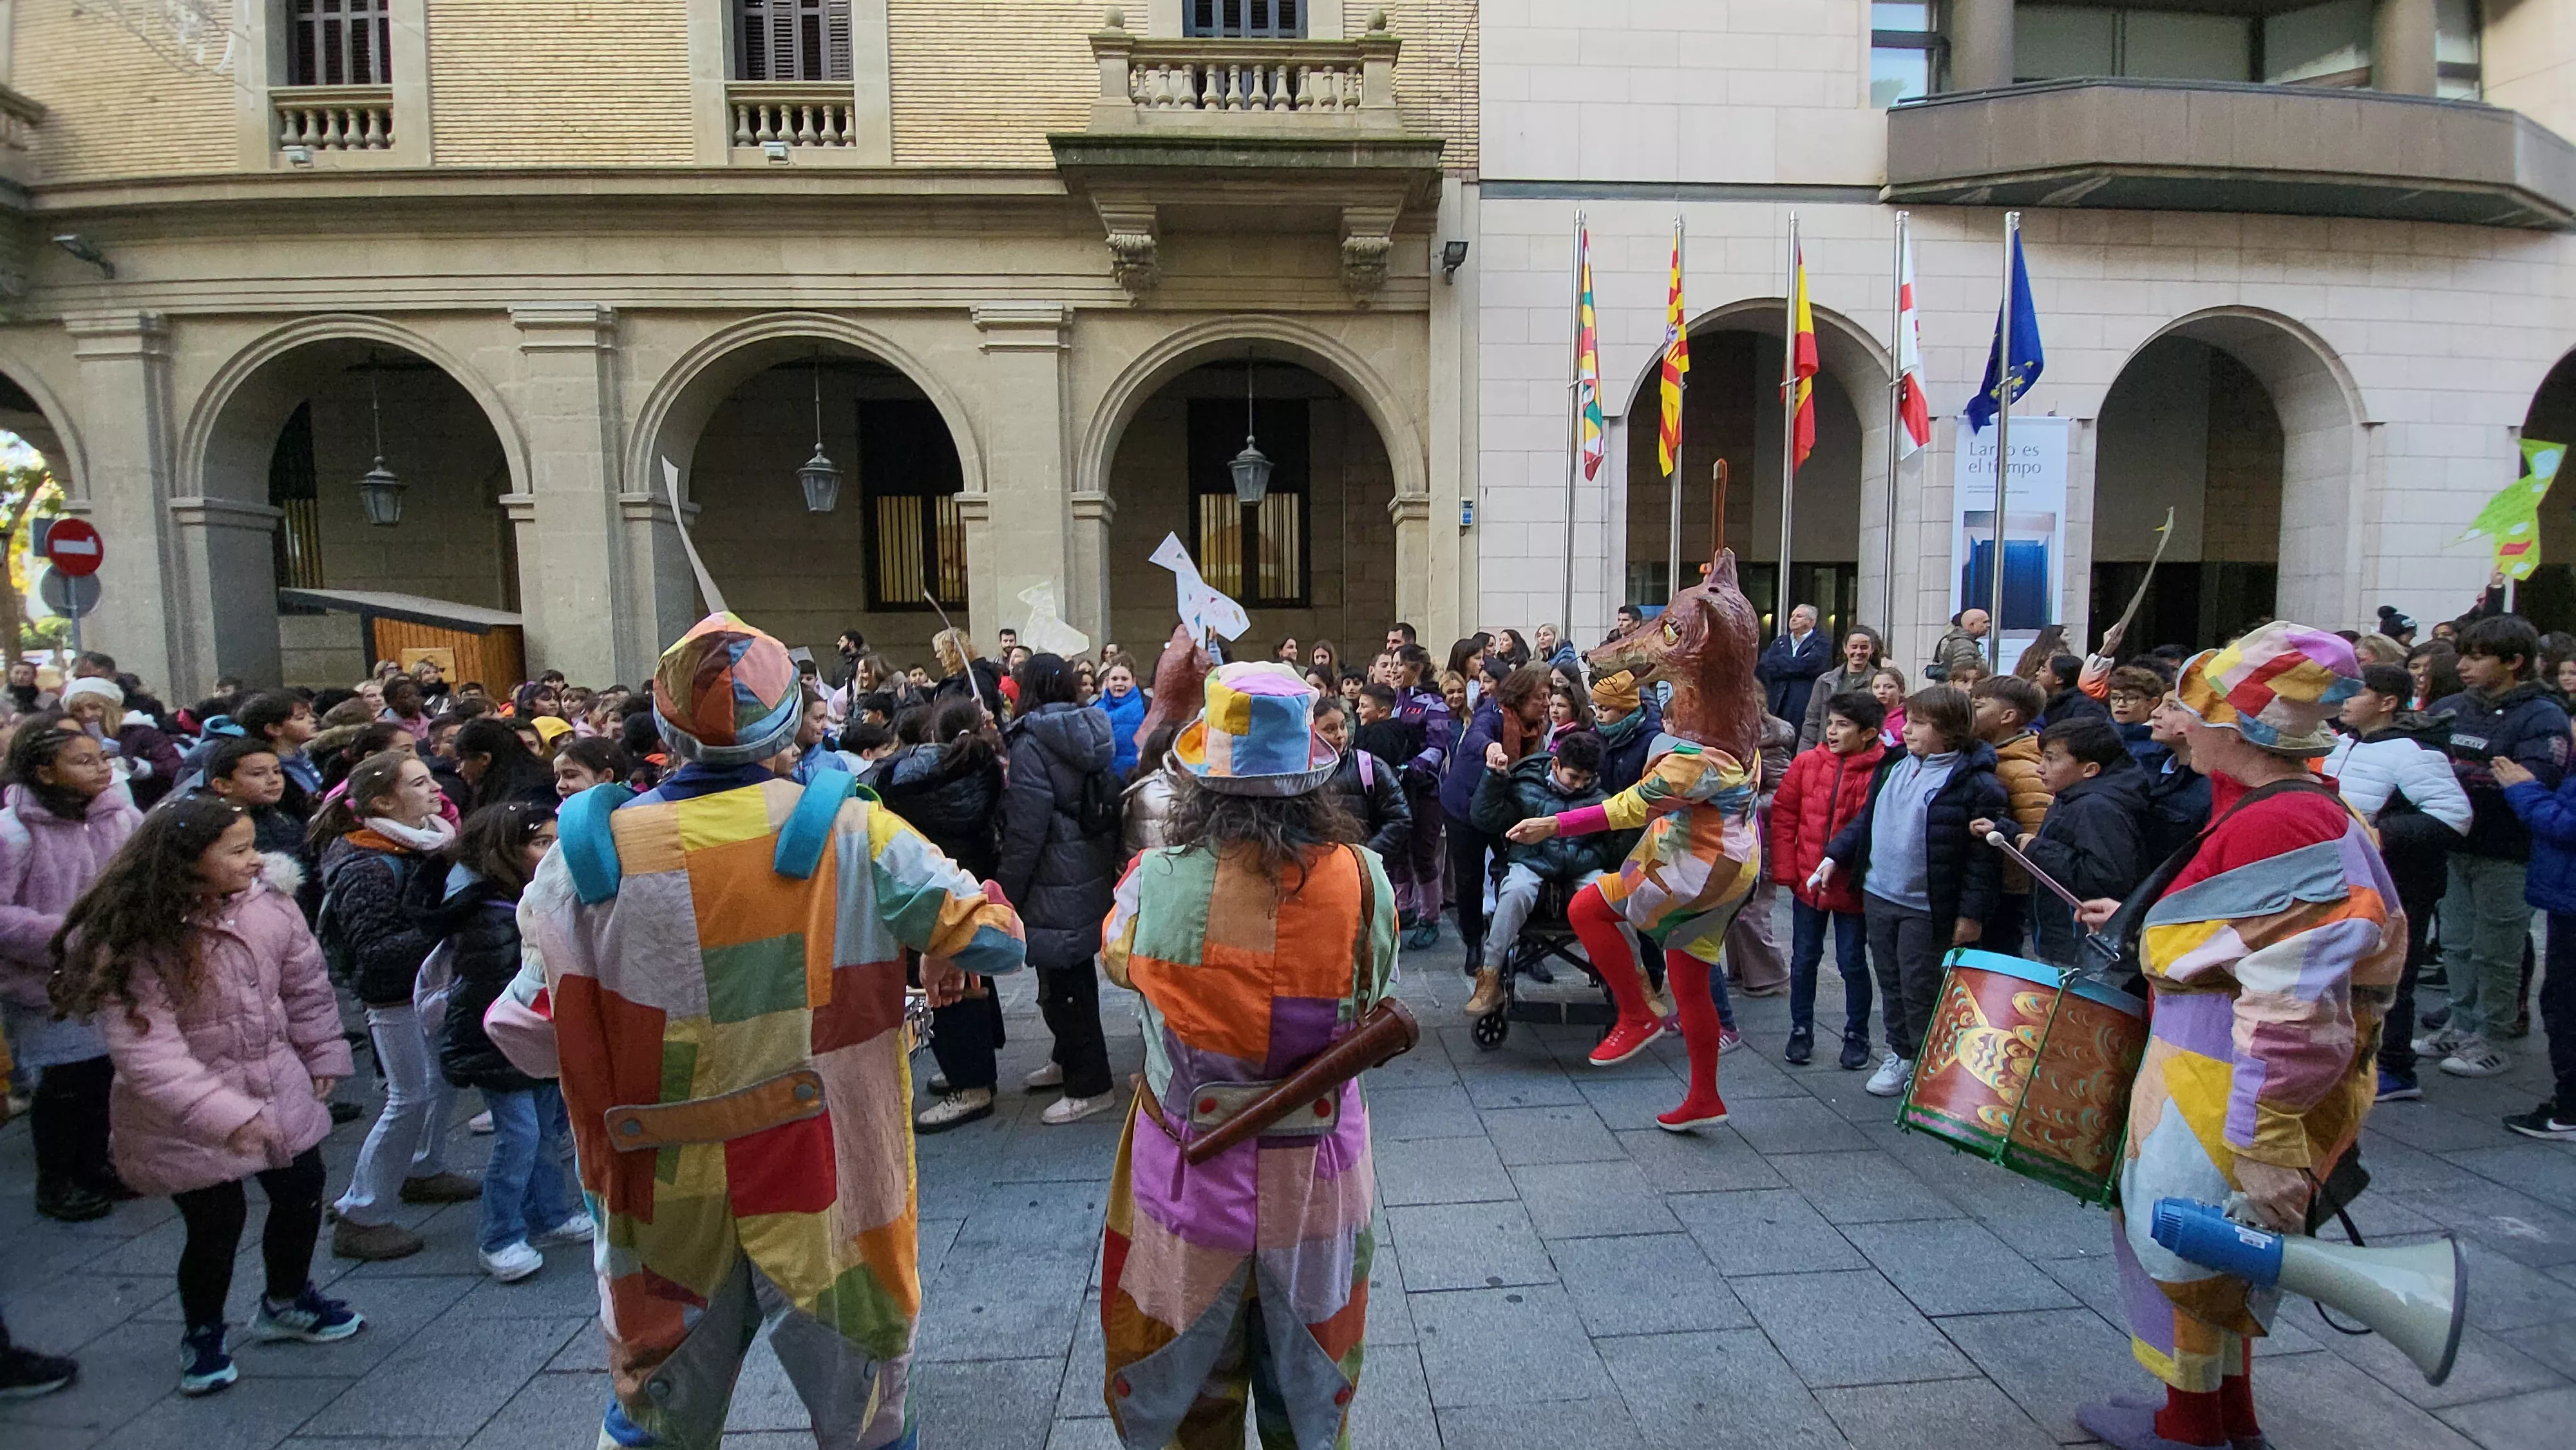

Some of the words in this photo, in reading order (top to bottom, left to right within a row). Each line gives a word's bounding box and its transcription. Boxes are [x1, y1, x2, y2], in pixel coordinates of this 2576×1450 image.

[1969, 441, 2016, 457] Laro
[2022, 445, 2040, 457] es
[1969, 458, 1982, 473] el
[1988, 458, 2041, 478] timpo
